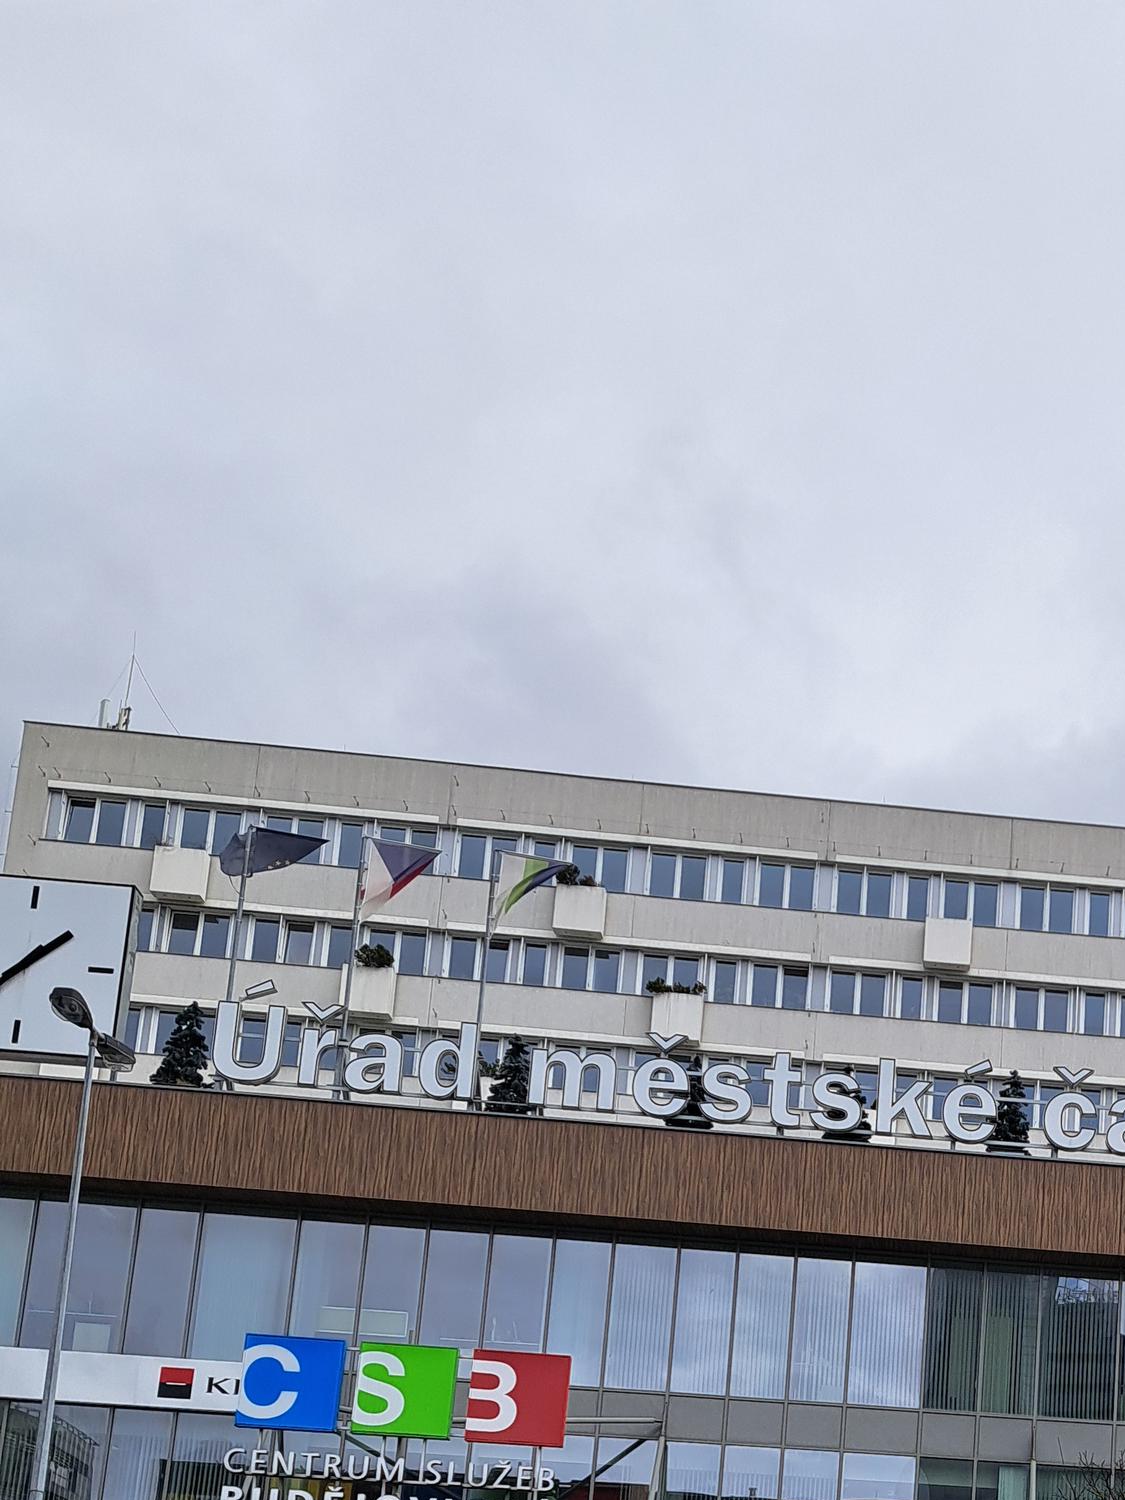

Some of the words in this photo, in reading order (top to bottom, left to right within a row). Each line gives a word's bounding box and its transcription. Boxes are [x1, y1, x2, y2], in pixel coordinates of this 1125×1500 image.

[211, 978, 478, 1102] Úřad
[529, 1030, 998, 1144] městské
[206, 1376, 241, 1395] K
[223, 1447, 406, 1484] CENTRUM
[426, 1459, 556, 1492] SLUŽEB
